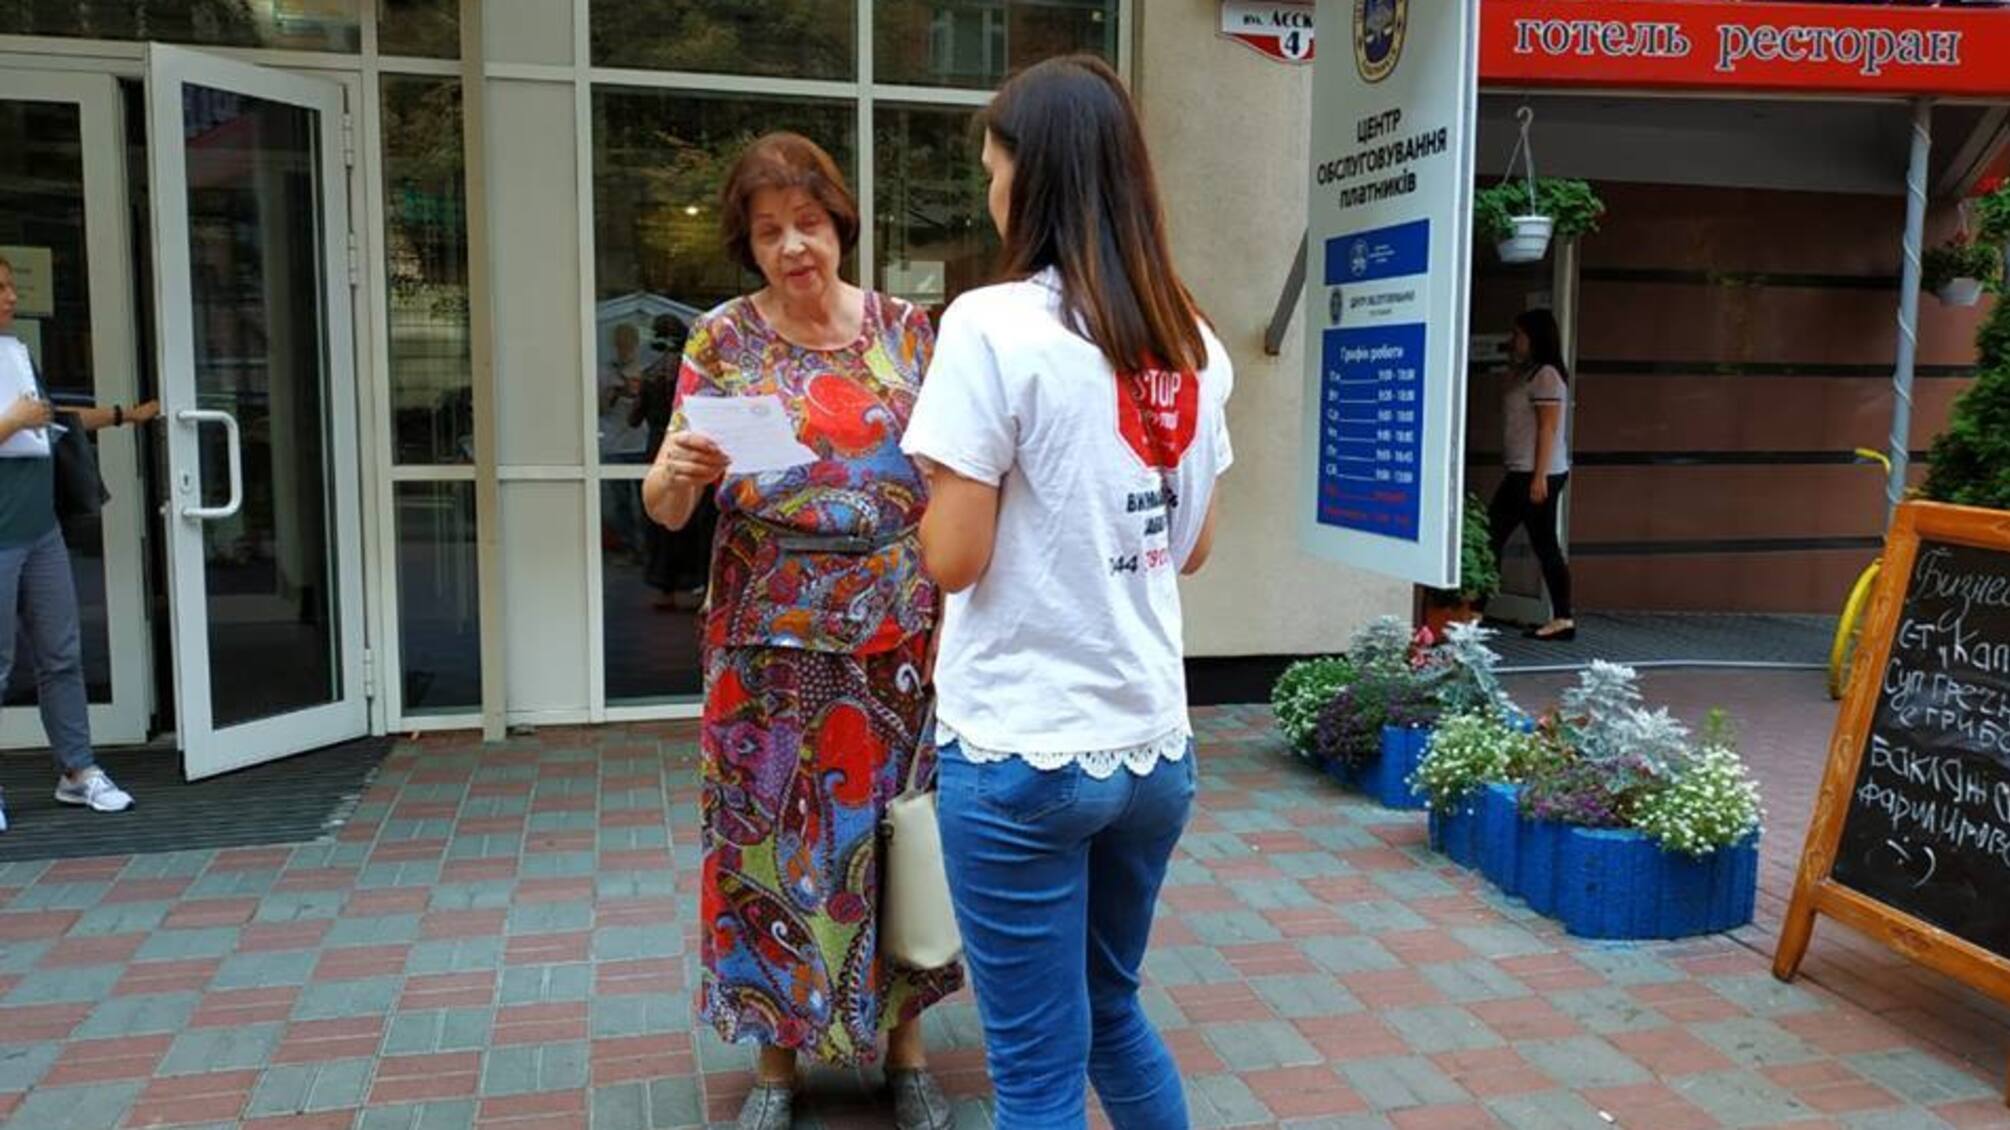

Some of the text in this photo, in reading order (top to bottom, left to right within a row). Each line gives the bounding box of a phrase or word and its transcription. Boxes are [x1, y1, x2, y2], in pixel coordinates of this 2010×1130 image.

[1284, 31, 1301, 55] 4
[1512, 18, 1963, 76] готель ресторан
[1357, 108, 1402, 144] ЦЕНТР
[1316, 128, 1448, 185] ОБСЛУГОВУВАННЯ
[1339, 169, 1417, 209] платників
[1133, 370, 1182, 407] STOP
